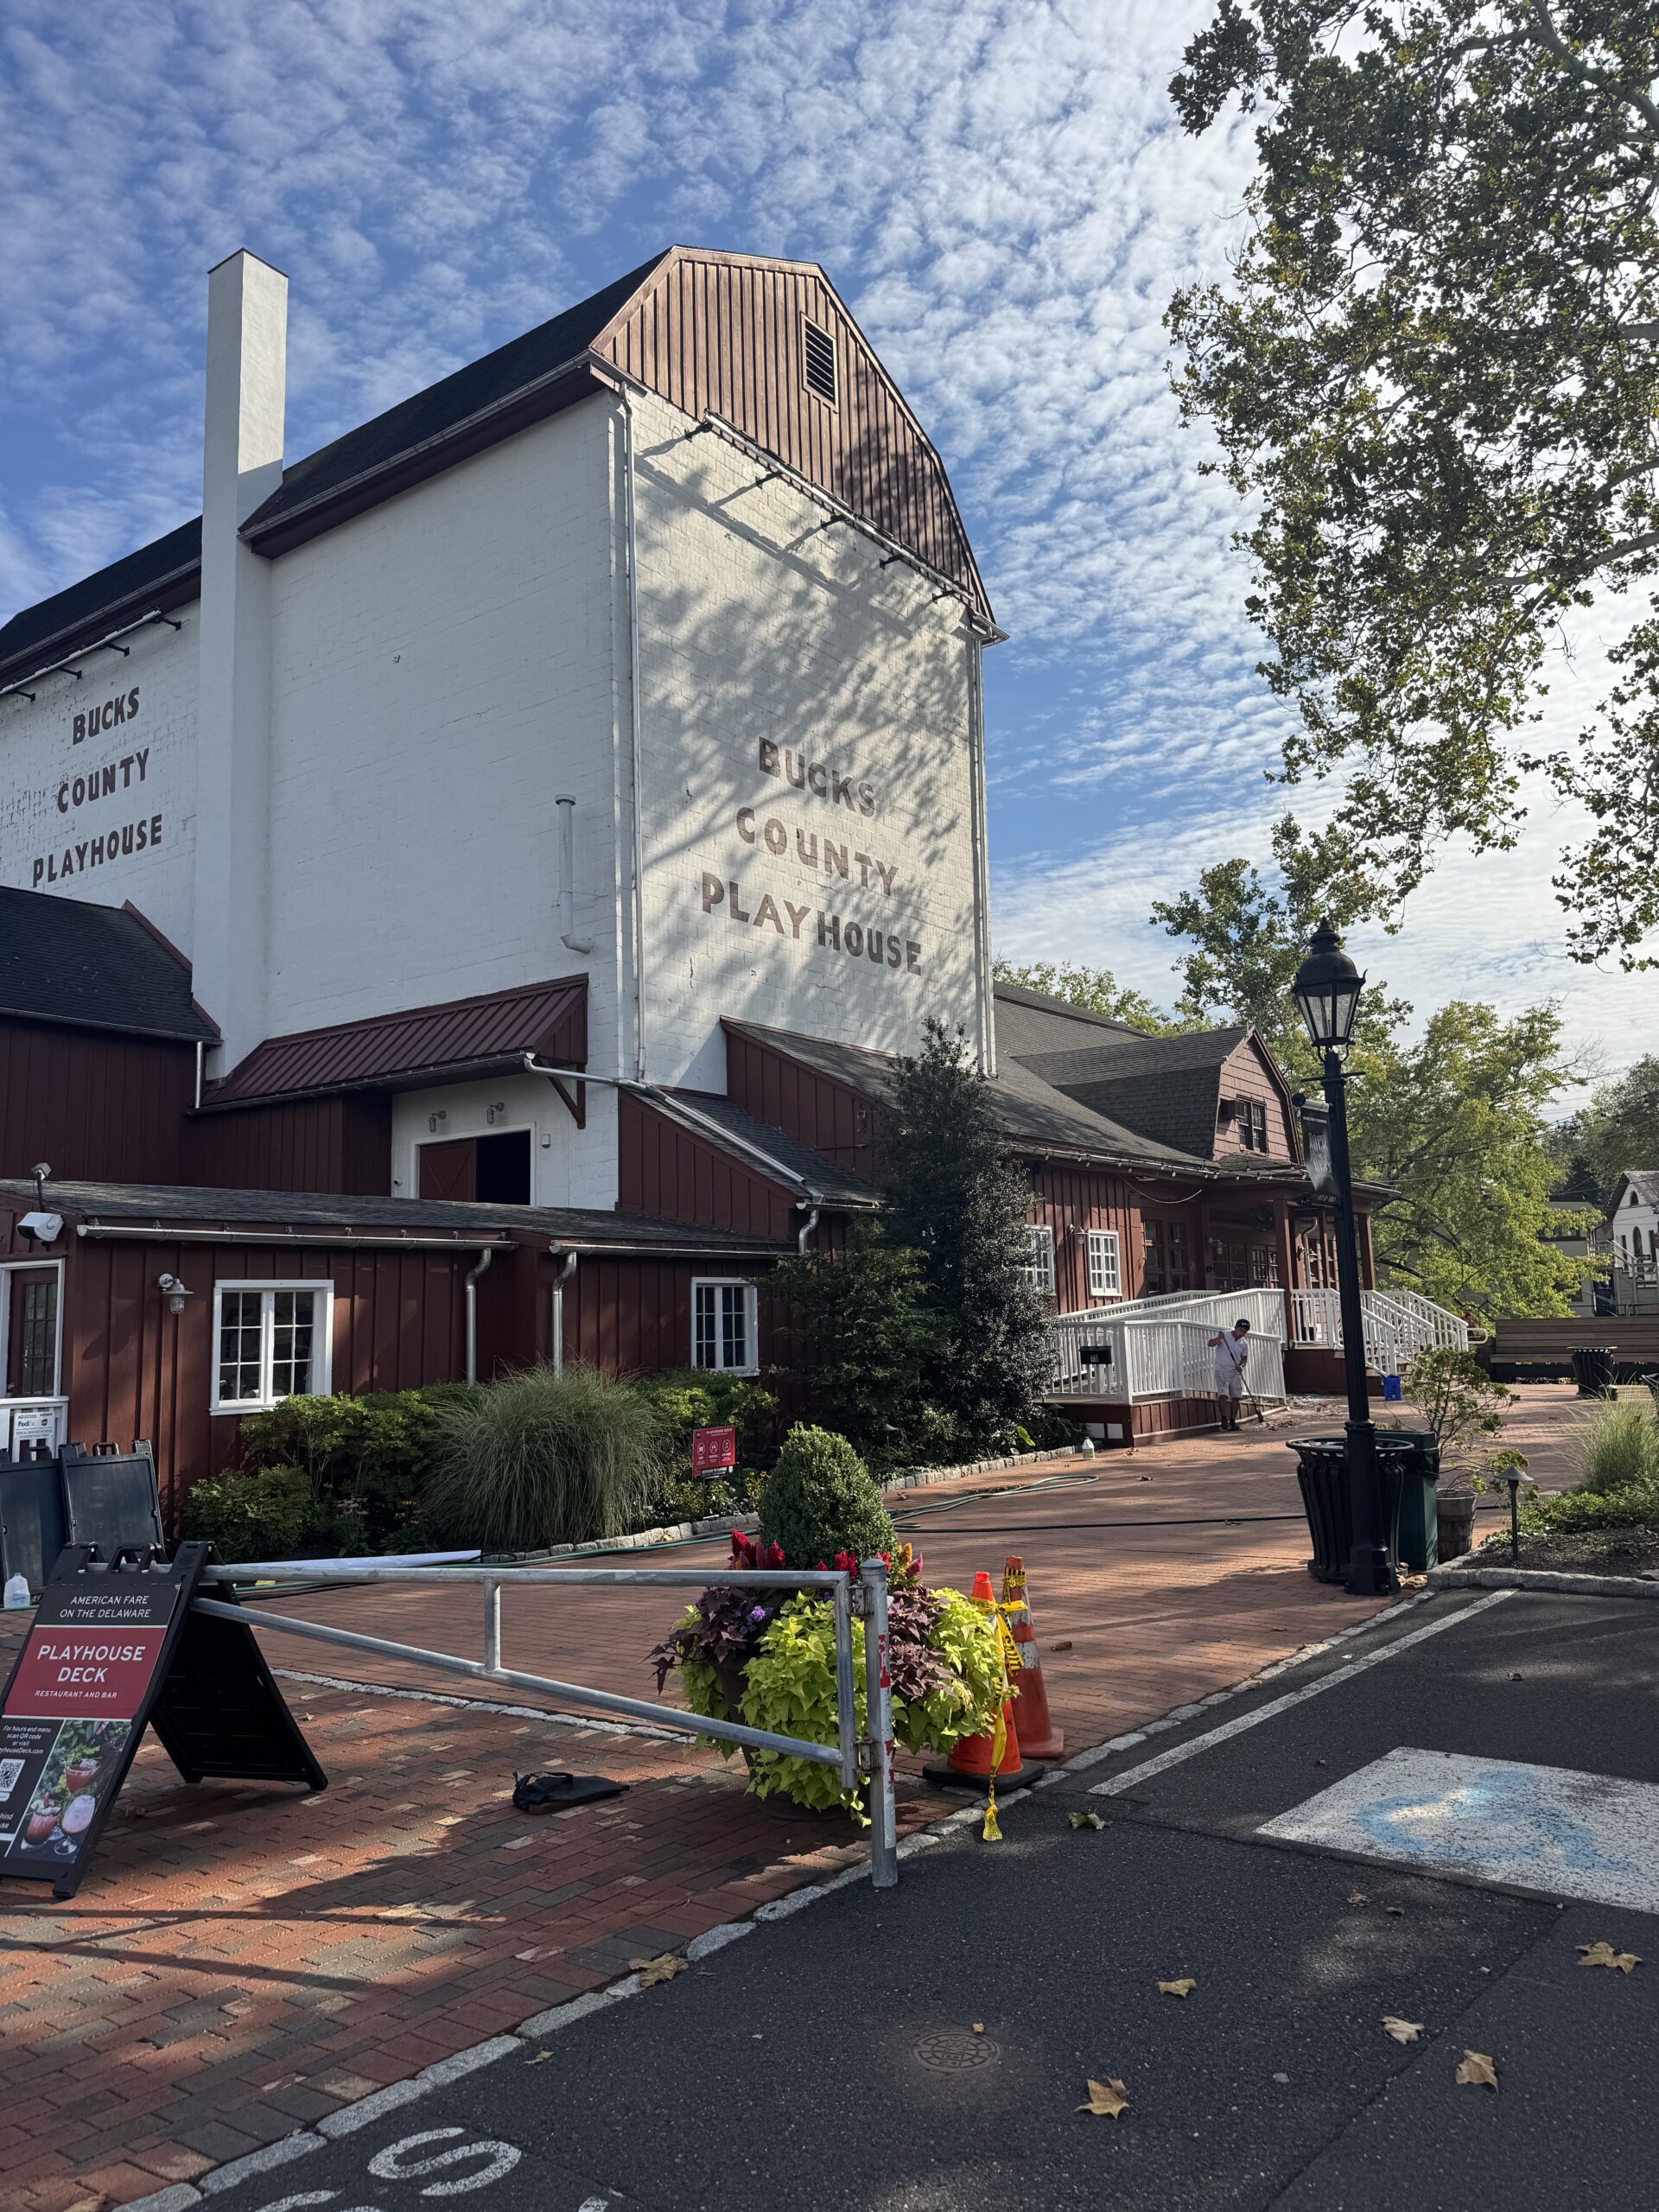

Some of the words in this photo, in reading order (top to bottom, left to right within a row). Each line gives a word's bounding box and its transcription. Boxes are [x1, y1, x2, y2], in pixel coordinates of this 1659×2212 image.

[73, 686, 140, 746] BUCKS
[57, 747, 149, 813] COUNTY
[759, 736, 876, 817] BUCKS
[33, 813, 162, 887] PLAYHOUSE
[736, 806, 899, 897] COUNTY
[702, 872, 921, 976] PLAYHOUSE
[60, 1609, 75, 1618] ON
[77, 1609, 96, 1618] THE
[97, 1609, 151, 1618] DELAWARE
[70, 1596, 121, 1605] AMERICAN
[123, 1596, 149, 1605] FARE
[37, 1645, 145, 1661] PLAYHOUSE
[57, 1667, 109, 1682] DECK
